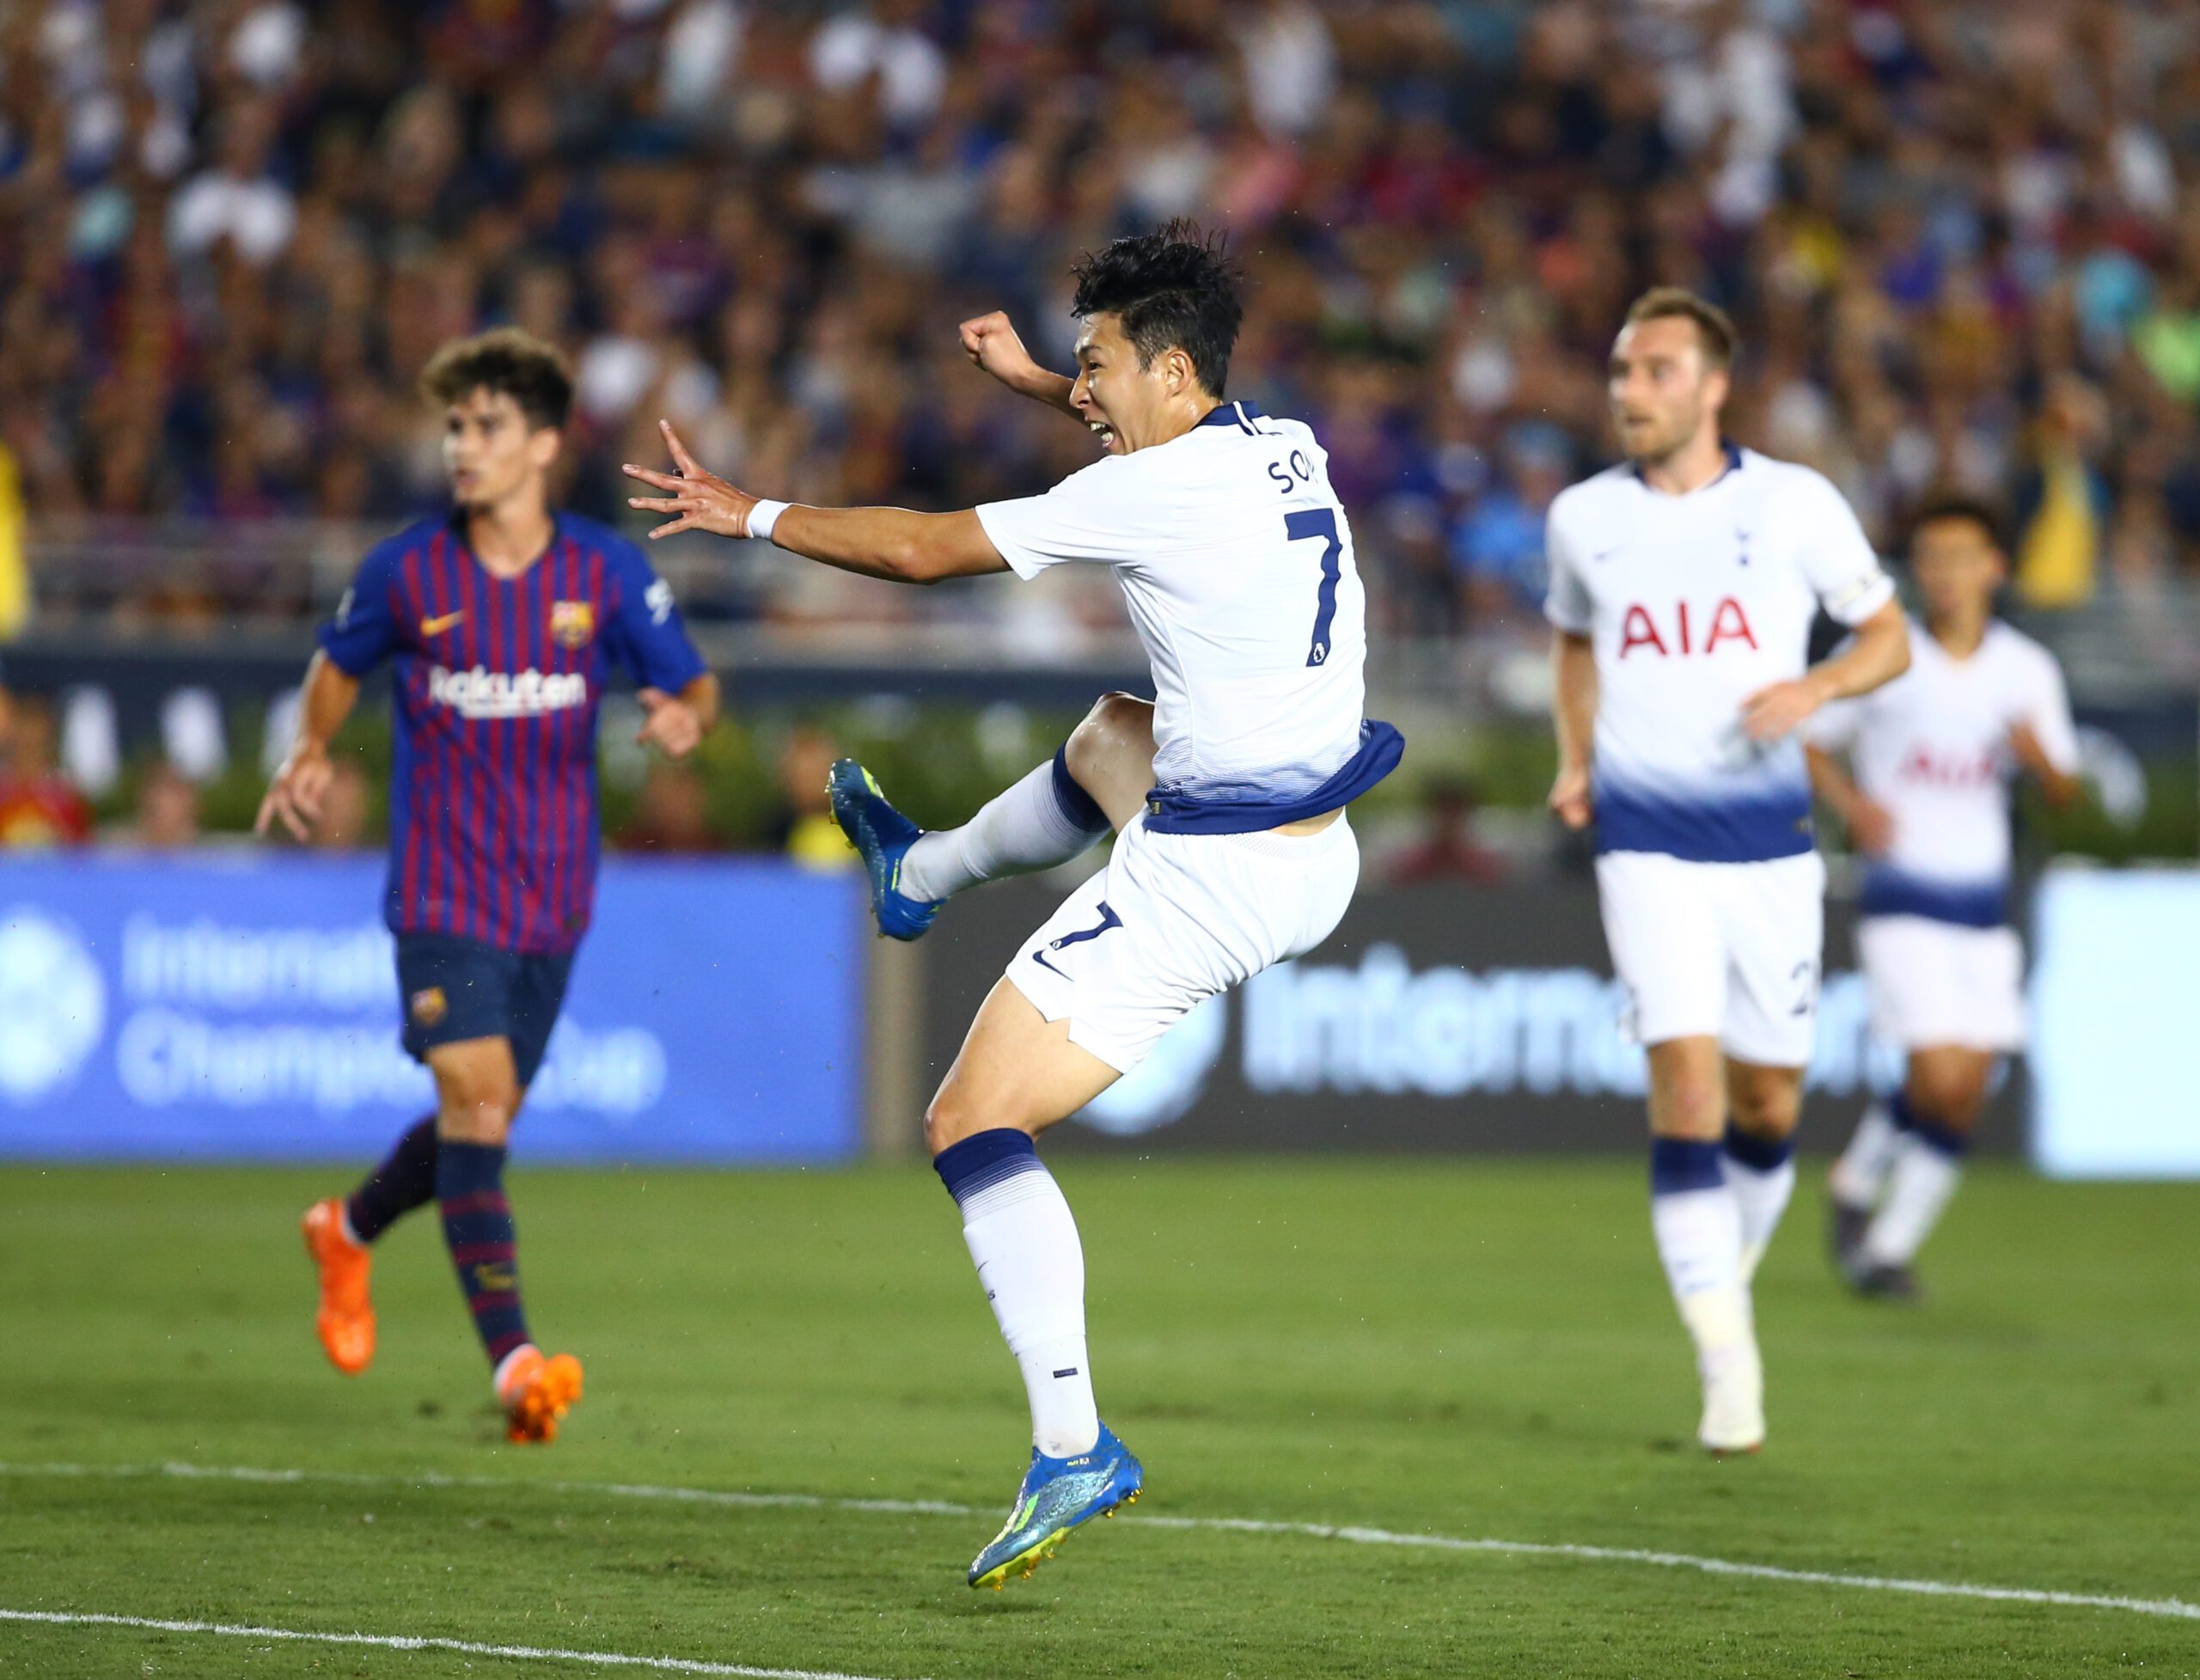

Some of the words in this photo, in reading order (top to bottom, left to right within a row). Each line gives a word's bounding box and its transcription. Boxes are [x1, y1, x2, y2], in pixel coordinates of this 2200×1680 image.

[1284, 508, 1342, 667] 7
[1620, 597, 1758, 658] AIA
[426, 663, 588, 718] Rakuten
[1049, 901, 1123, 950] 7
